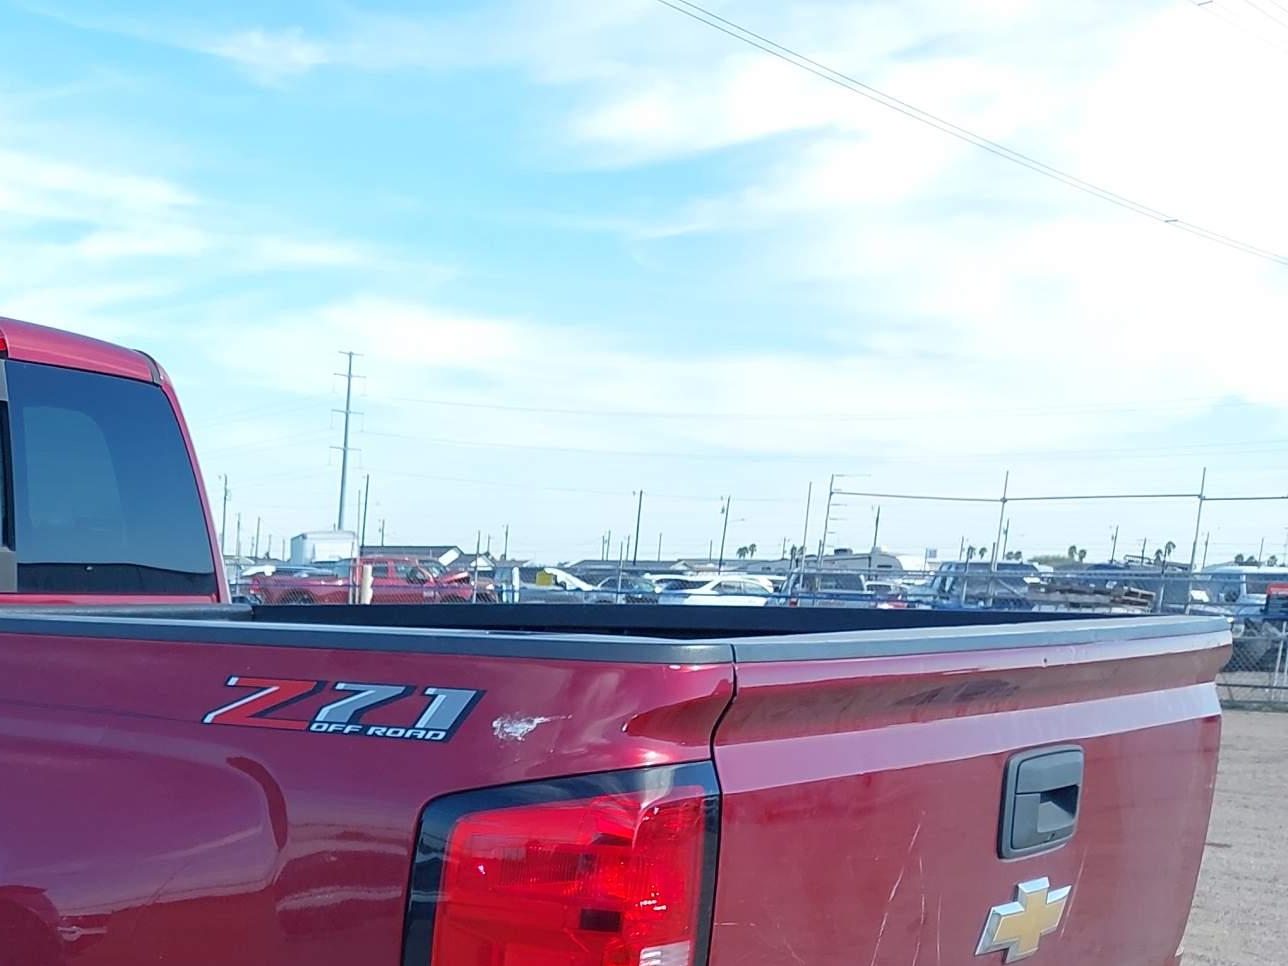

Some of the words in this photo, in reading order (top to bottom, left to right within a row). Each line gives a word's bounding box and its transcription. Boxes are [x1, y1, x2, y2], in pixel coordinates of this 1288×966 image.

[203, 676, 482, 732] Z71
[309, 722, 362, 735] OFF
[366, 726, 449, 741] ROAD
